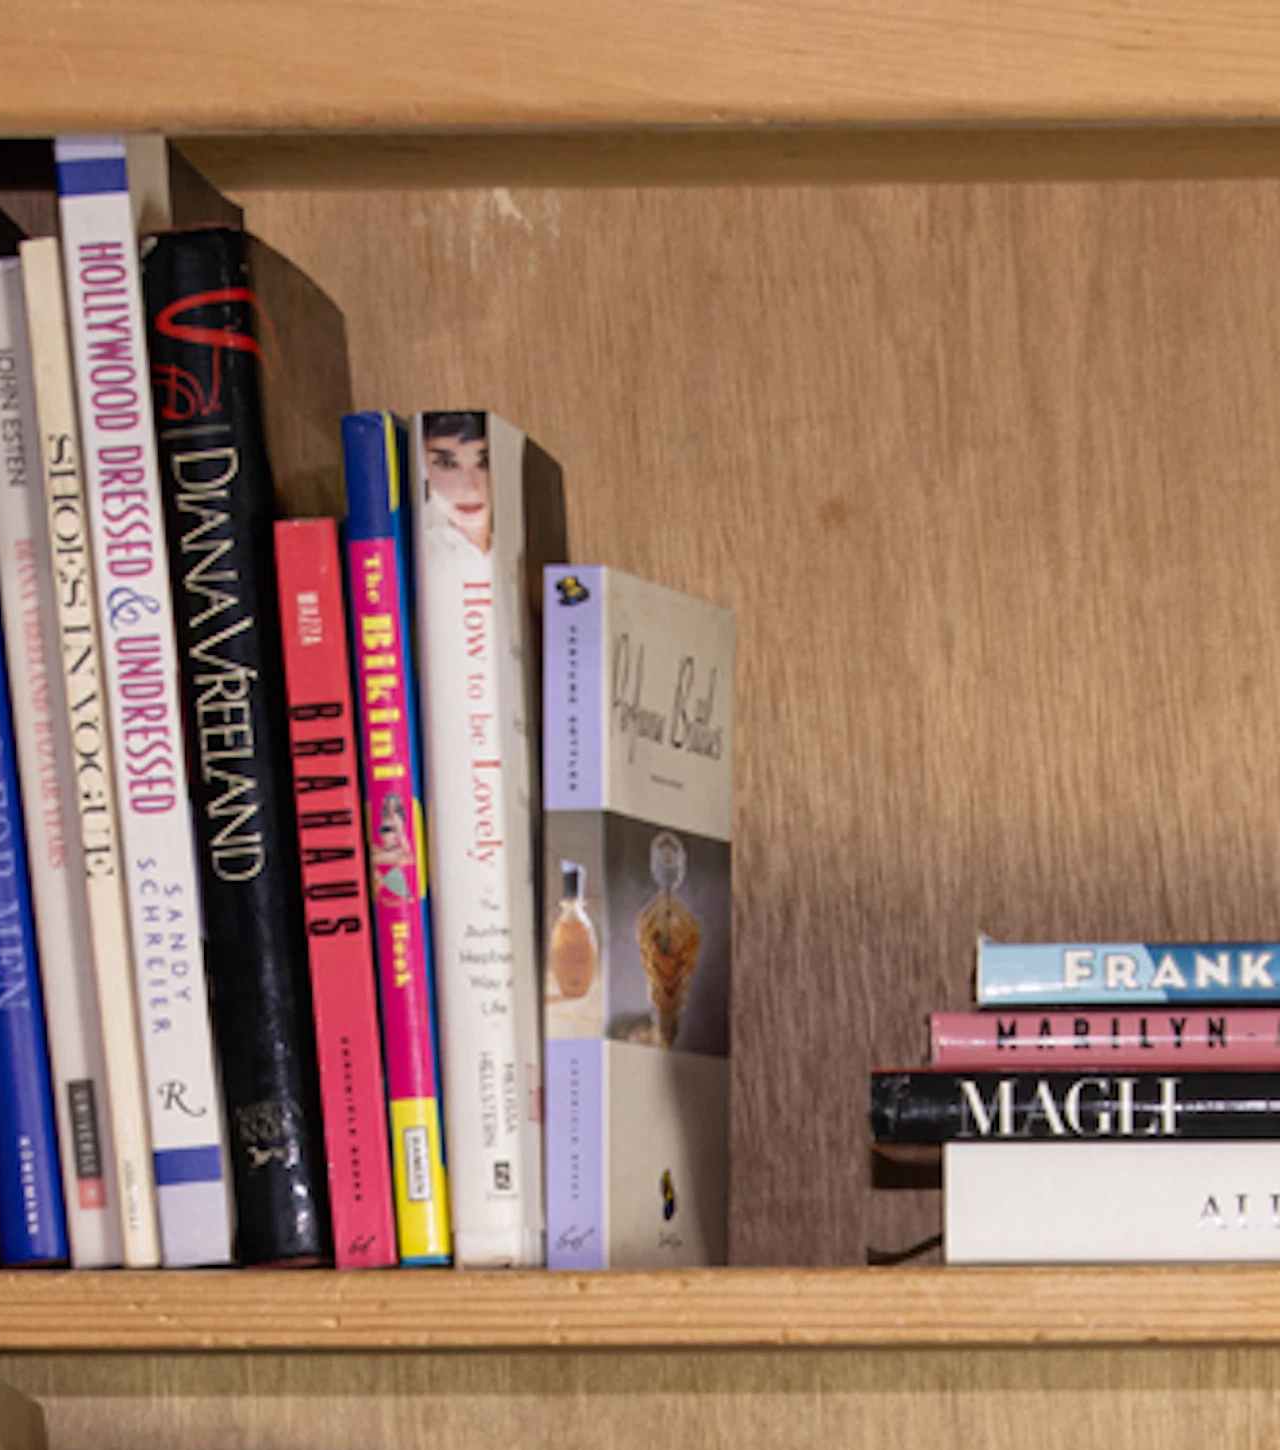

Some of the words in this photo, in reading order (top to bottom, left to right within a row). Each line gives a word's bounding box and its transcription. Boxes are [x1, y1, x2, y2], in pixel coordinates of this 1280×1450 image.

[79, 242, 139, 433] HOLLYWOOD
[4, 420, 28, 488] ESTEN
[98, 444, 153, 579] DRESSED
[107, 586, 161, 630] &
[463, 582, 492, 664] How
[467, 672, 488, 701] to
[116, 634, 177, 815] UNDRESSED
[468, 713, 493, 747] be
[467, 760, 503, 868] Lovely
[136, 858, 172, 1034] SCHREIER
[165, 884, 192, 1004] SANDY
[1061, 950, 1276, 991] FRANK
[995, 1016, 1229, 1050] MARILYN
[956, 1078, 1183, 1138] MAGLI
